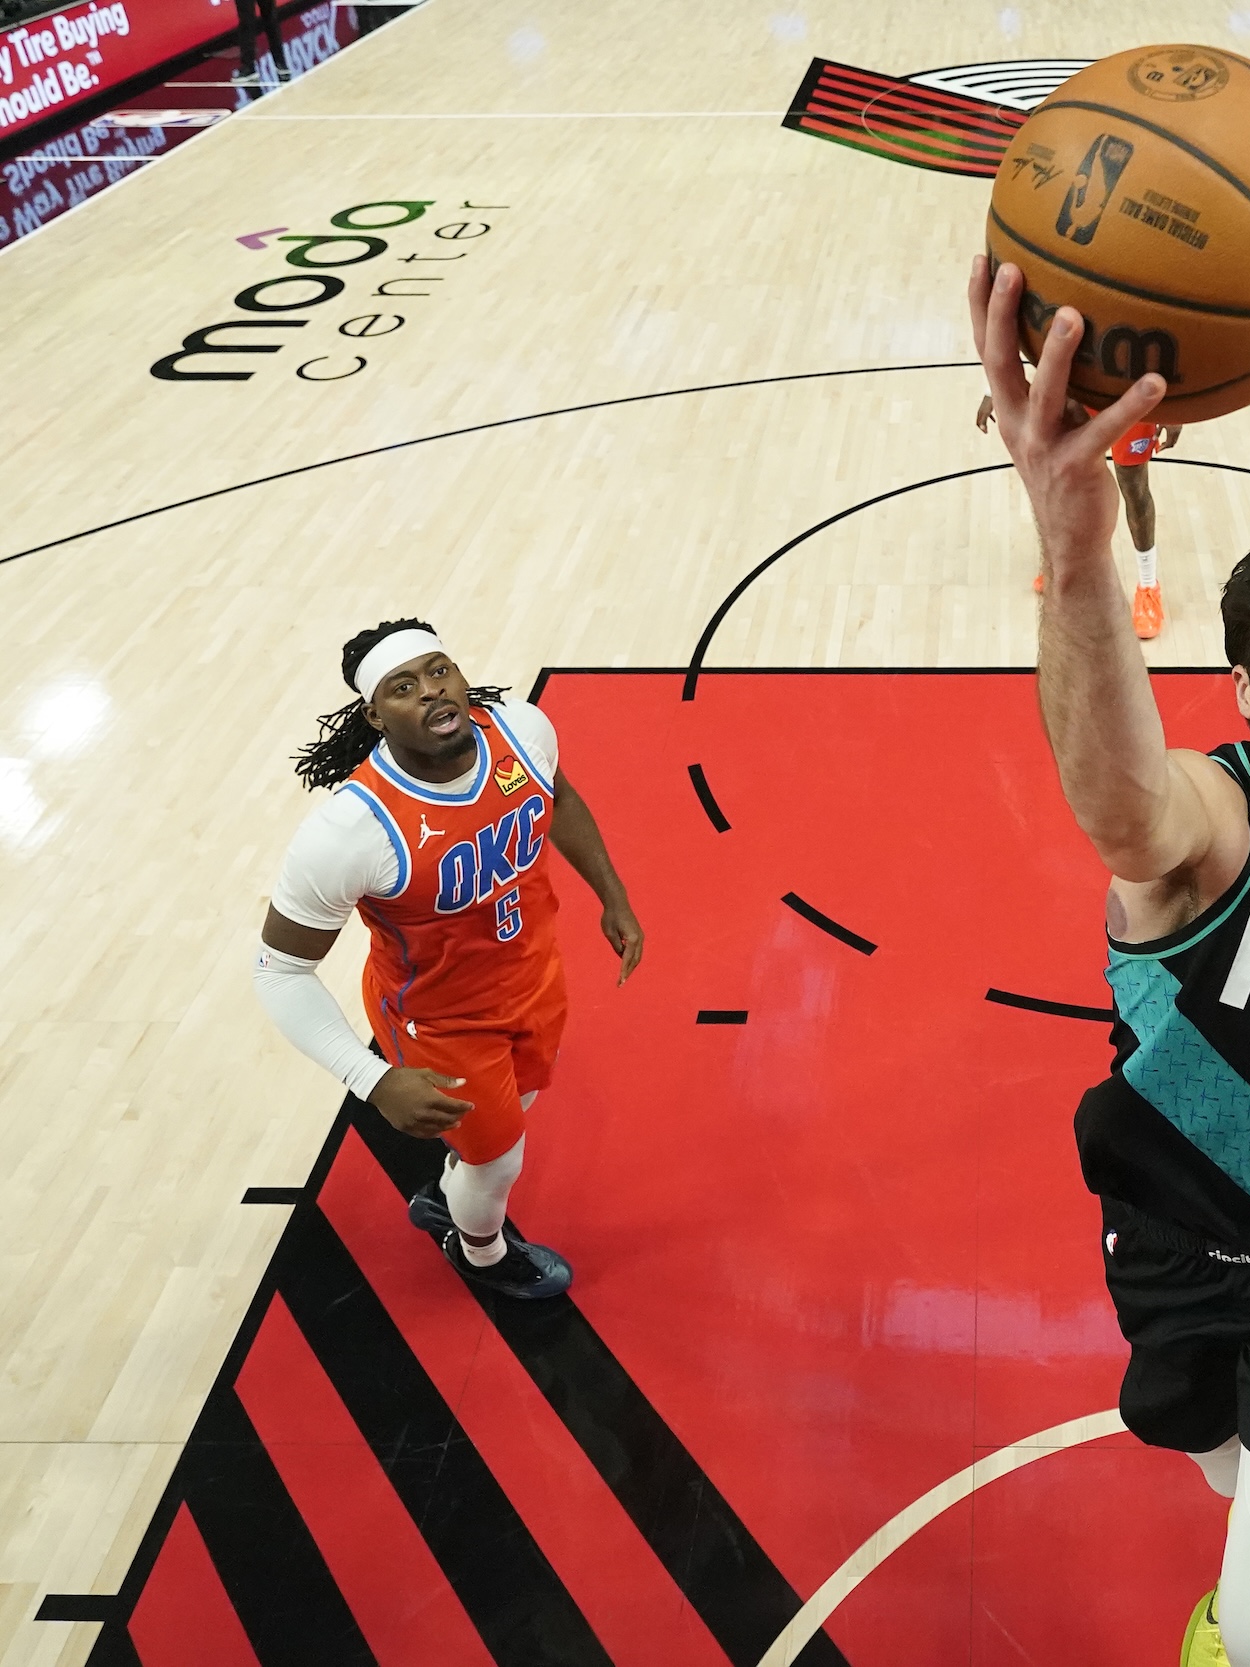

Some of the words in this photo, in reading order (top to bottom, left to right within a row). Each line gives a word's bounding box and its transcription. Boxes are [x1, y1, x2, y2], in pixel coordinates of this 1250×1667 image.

[7, 28, 58, 68] Tire
[52, 2, 129, 49] Buying
[0, 67, 64, 128] hould
[150, 200, 437, 381] moda
[296, 200, 510, 381] center
[434, 794, 546, 915] OKC
[496, 886, 522, 943] 5
